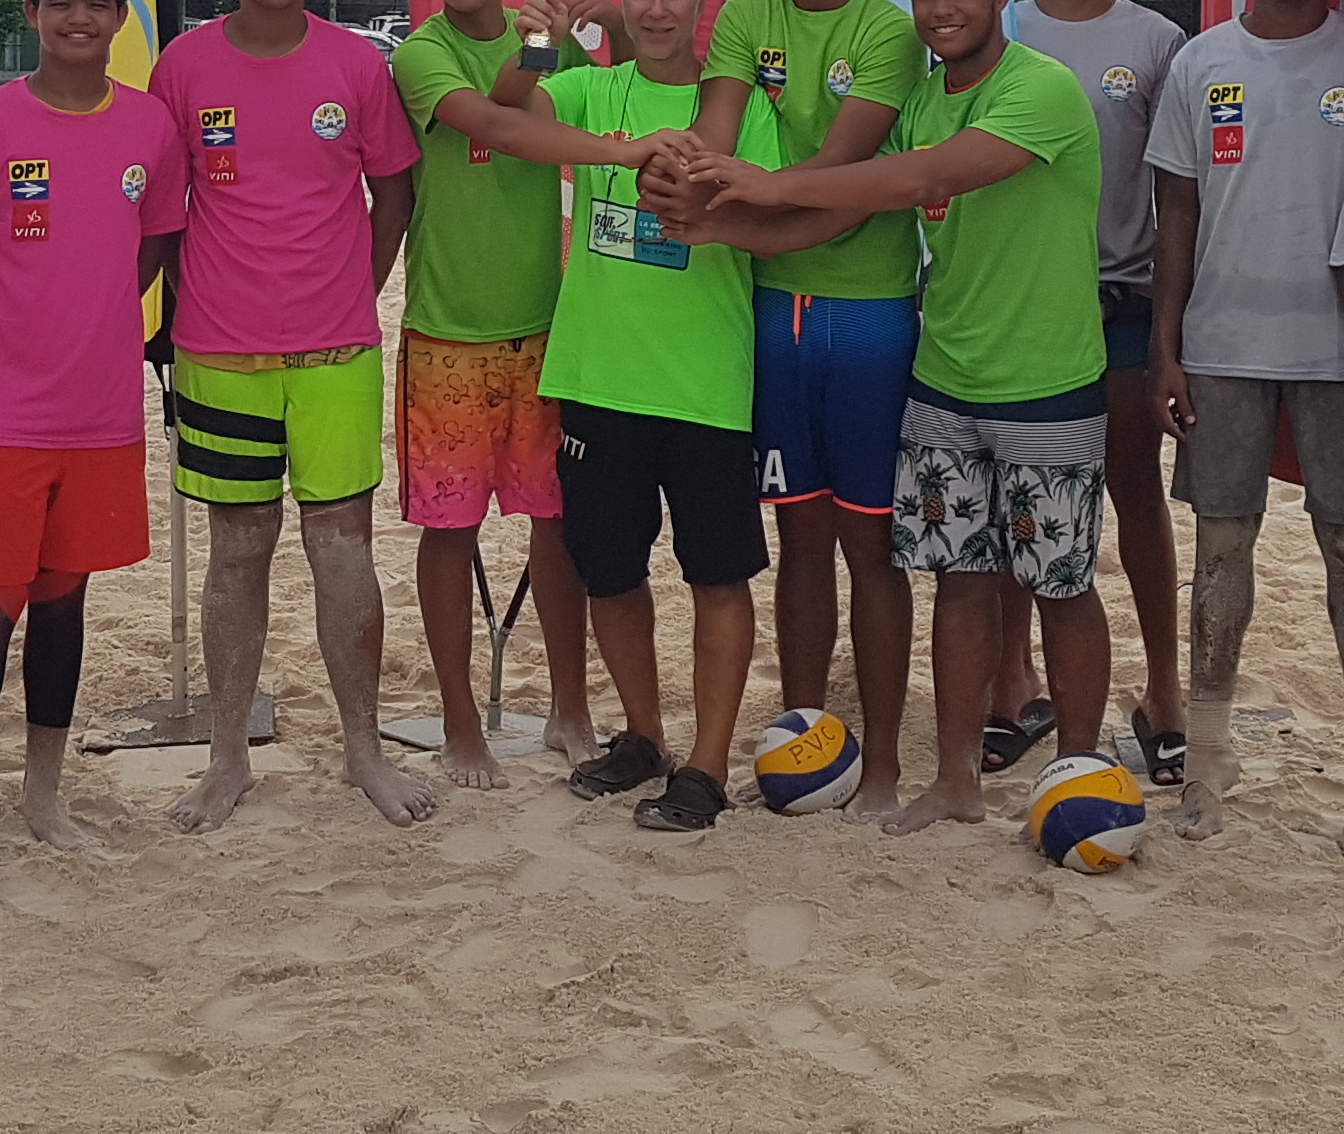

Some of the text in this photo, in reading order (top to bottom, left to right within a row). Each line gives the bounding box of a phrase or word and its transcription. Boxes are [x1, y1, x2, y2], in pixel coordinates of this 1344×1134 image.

[1209, 85, 1241, 103] OPT
[201, 109, 233, 126] OPT
[10, 162, 46, 180] OPT
[561, 428, 586, 461] ITI
